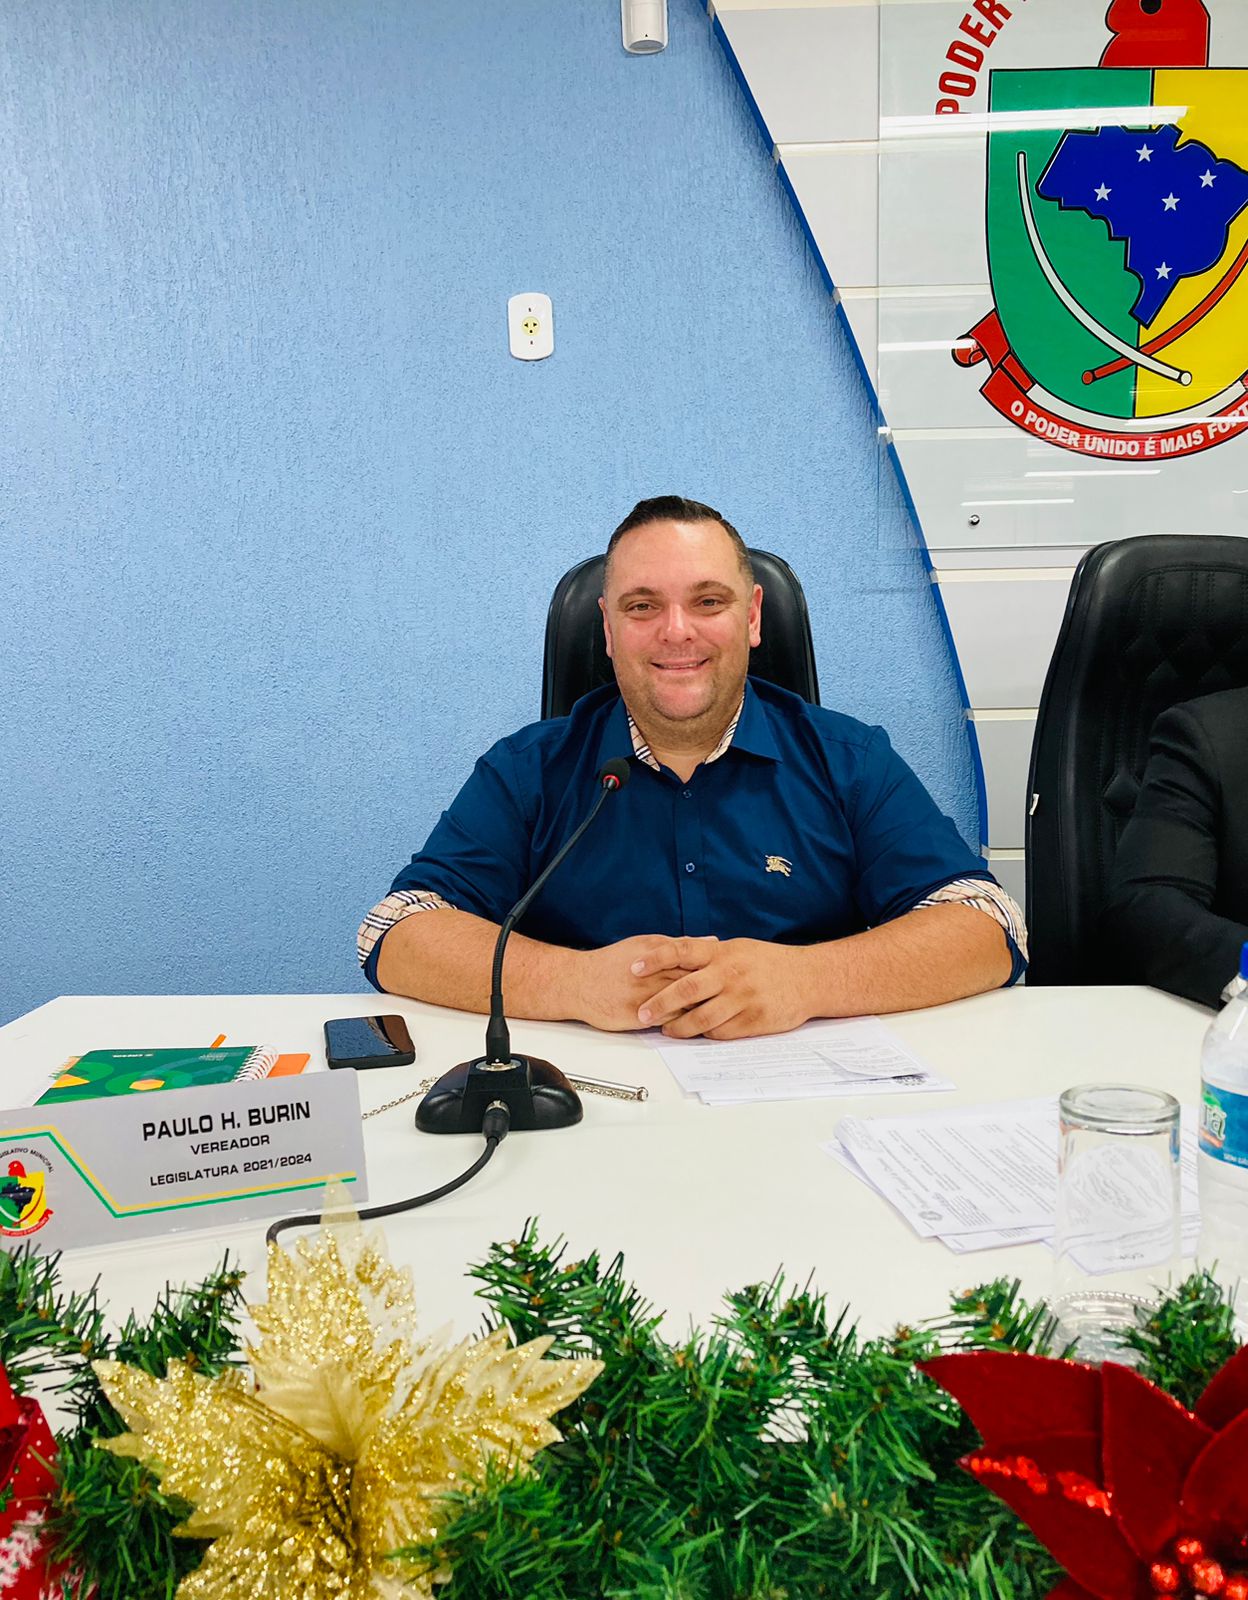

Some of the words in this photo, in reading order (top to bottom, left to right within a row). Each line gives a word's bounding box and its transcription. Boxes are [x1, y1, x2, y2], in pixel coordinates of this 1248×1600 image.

[936, 0, 1013, 115] PODER
[1010, 400, 1024, 417] O
[1024, 412, 1079, 447] PODER
[1084, 434, 1140, 456] UNIDO
[1144, 436, 1156, 456] É
[1160, 429, 1204, 454] MAIS
[142, 1114, 213, 1141] PAULO
[221, 1111, 241, 1130] H.
[248, 1101, 311, 1127] BURIN
[190, 1134, 270, 1155] VEREADOR
[150, 1164, 239, 1187] LEGISLATURA
[243, 1153, 312, 1173] 2021/2024
